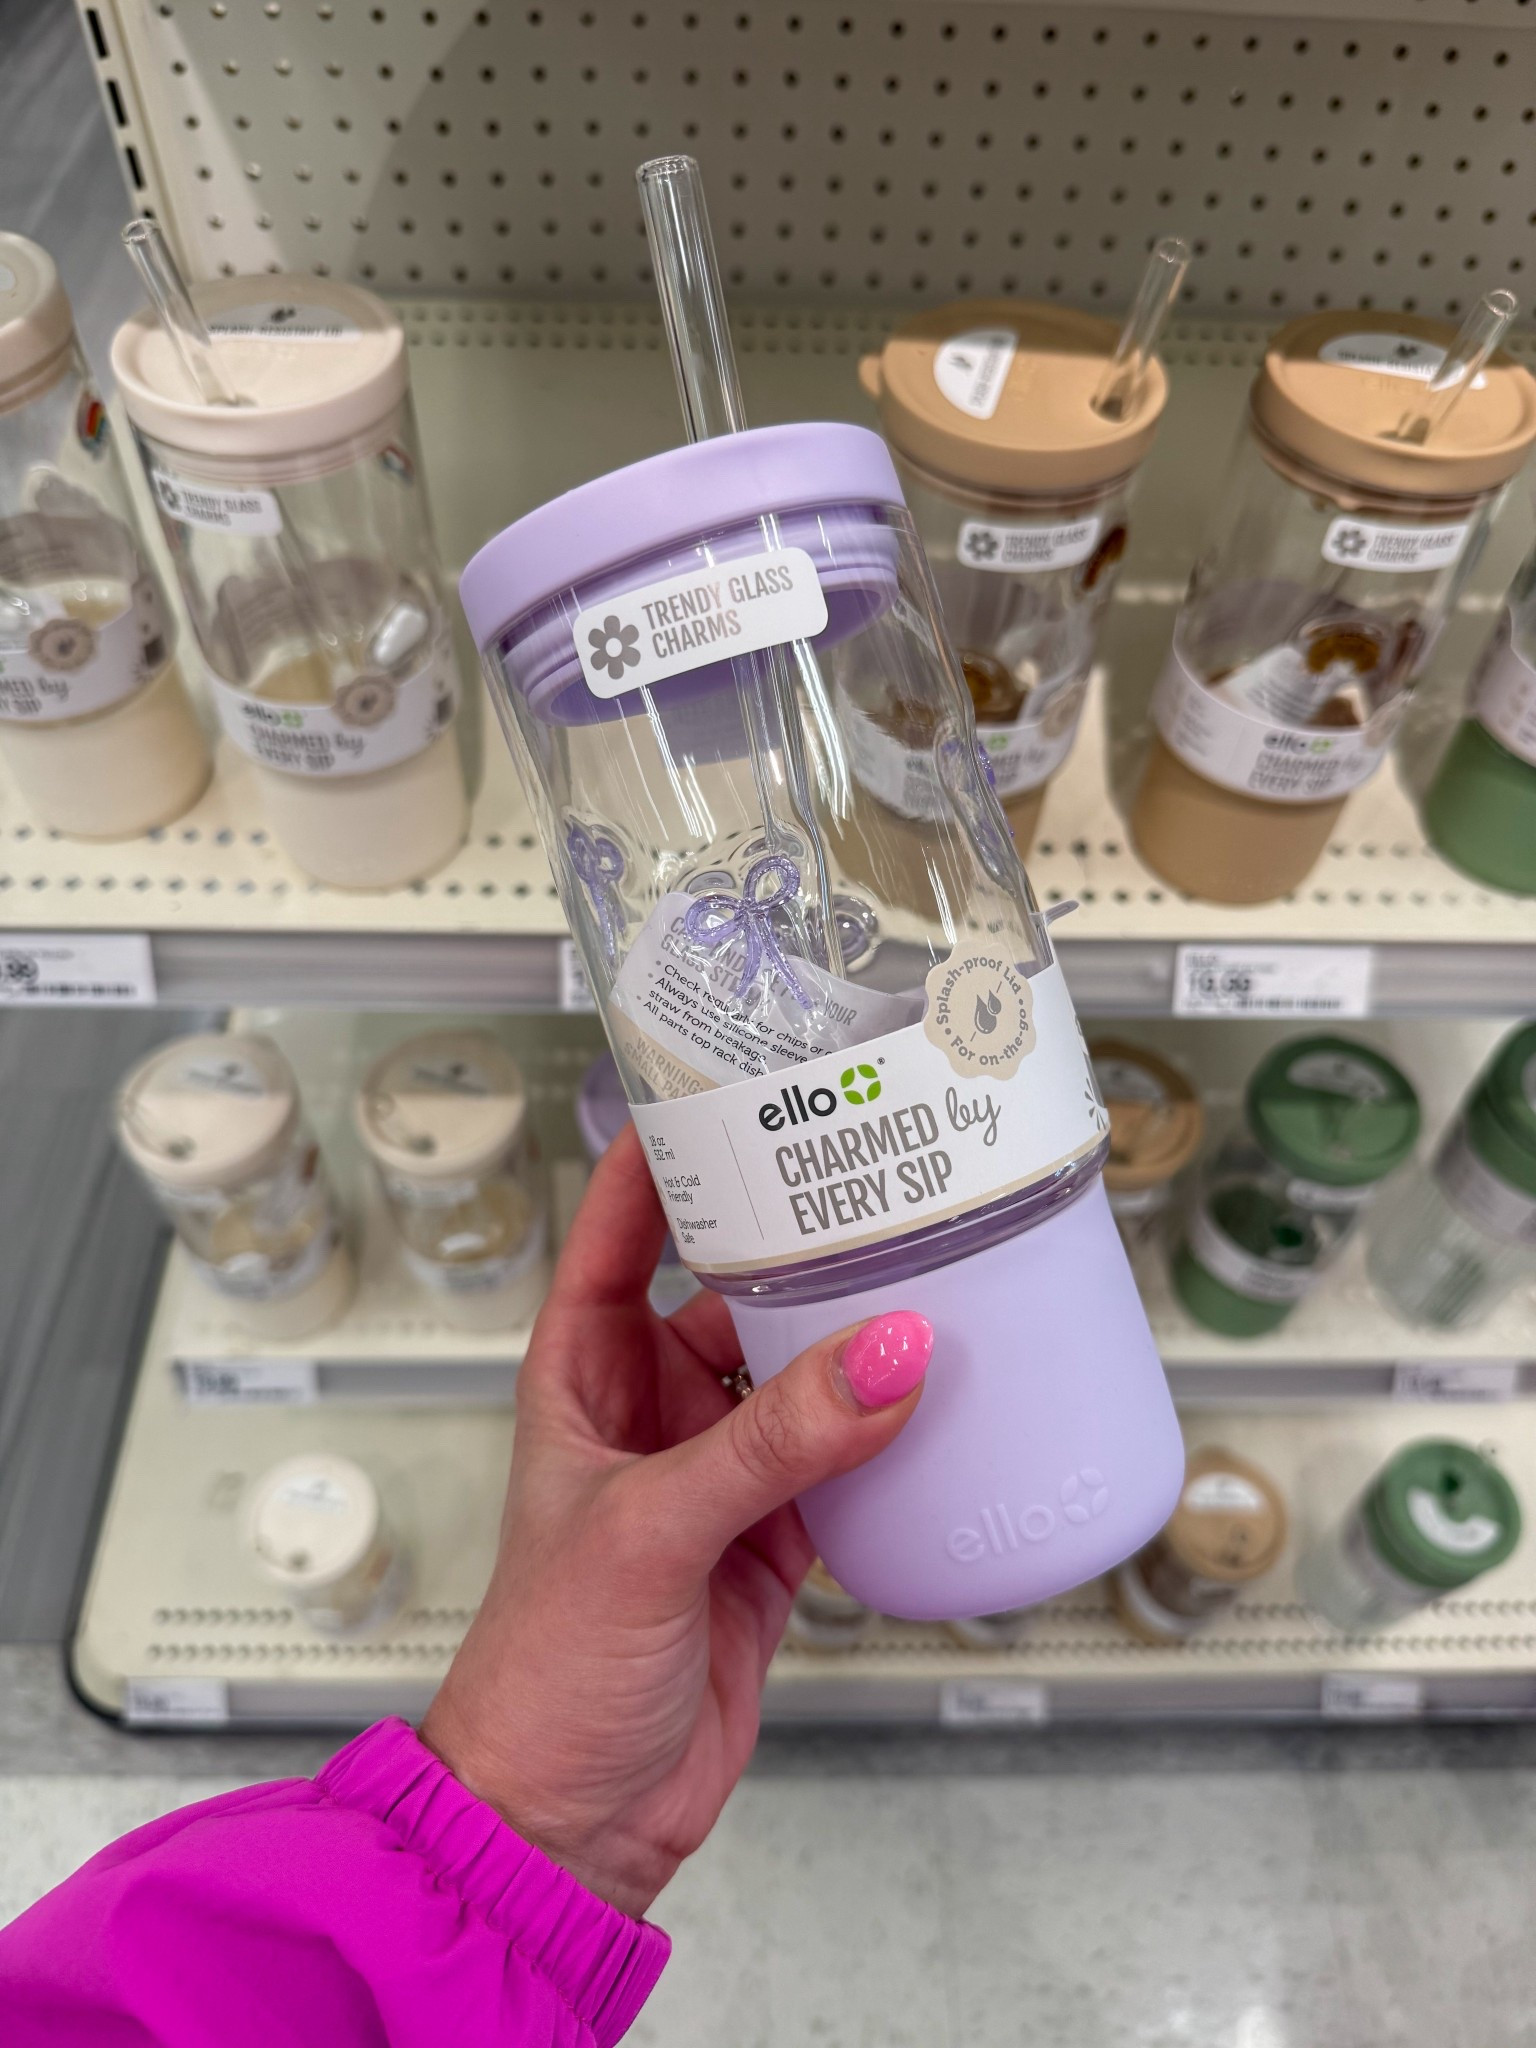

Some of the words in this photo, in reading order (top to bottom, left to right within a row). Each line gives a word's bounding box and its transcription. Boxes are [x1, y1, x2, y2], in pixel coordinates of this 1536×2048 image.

[640, 580, 722, 630] TRENDY
[728, 565, 794, 604] GLASS
[651, 609, 742, 658] CHARMS
[648, 989, 681, 1015] straw
[682, 1011, 713, 1035] from
[664, 964, 701, 994] Check
[756, 1021, 775, 1036] for
[776, 1031, 808, 1050] chips
[810, 1046, 824, 1055] or
[935, 956, 1003, 1025] Splash-proof
[1003, 966, 1021, 995] Lid
[643, 1001, 658, 1016] All
[659, 1010, 689, 1036] parts
[691, 1032, 711, 1050] top
[712, 1045, 739, 1066] rack
[654, 976, 699, 1009] Always
[700, 1006, 721, 1023] use
[723, 1020, 769, 1046] silicone
[770, 1044, 808, 1063] sleeve
[950, 1036, 976, 1061] For
[979, 1008, 1029, 1066] on-the-go
[624, 1042, 660, 1085] SMALL
[758, 1084, 838, 1132] ello
[657, 1136, 666, 1147] oz
[665, 1148, 676, 1160] ml
[775, 1103, 940, 1188] CHARMED
[945, 1086, 1002, 1147] by
[662, 1176, 675, 1188] Hot
[680, 1174, 701, 1188] Cold
[667, 1190, 694, 1205] Friendly
[788, 1168, 891, 1236] EVERY
[896, 1150, 953, 1204] SIP
[676, 1217, 718, 1230] Dishwasher
[681, 1231, 696, 1244] Safe
[946, 1503, 1055, 1563] ello
